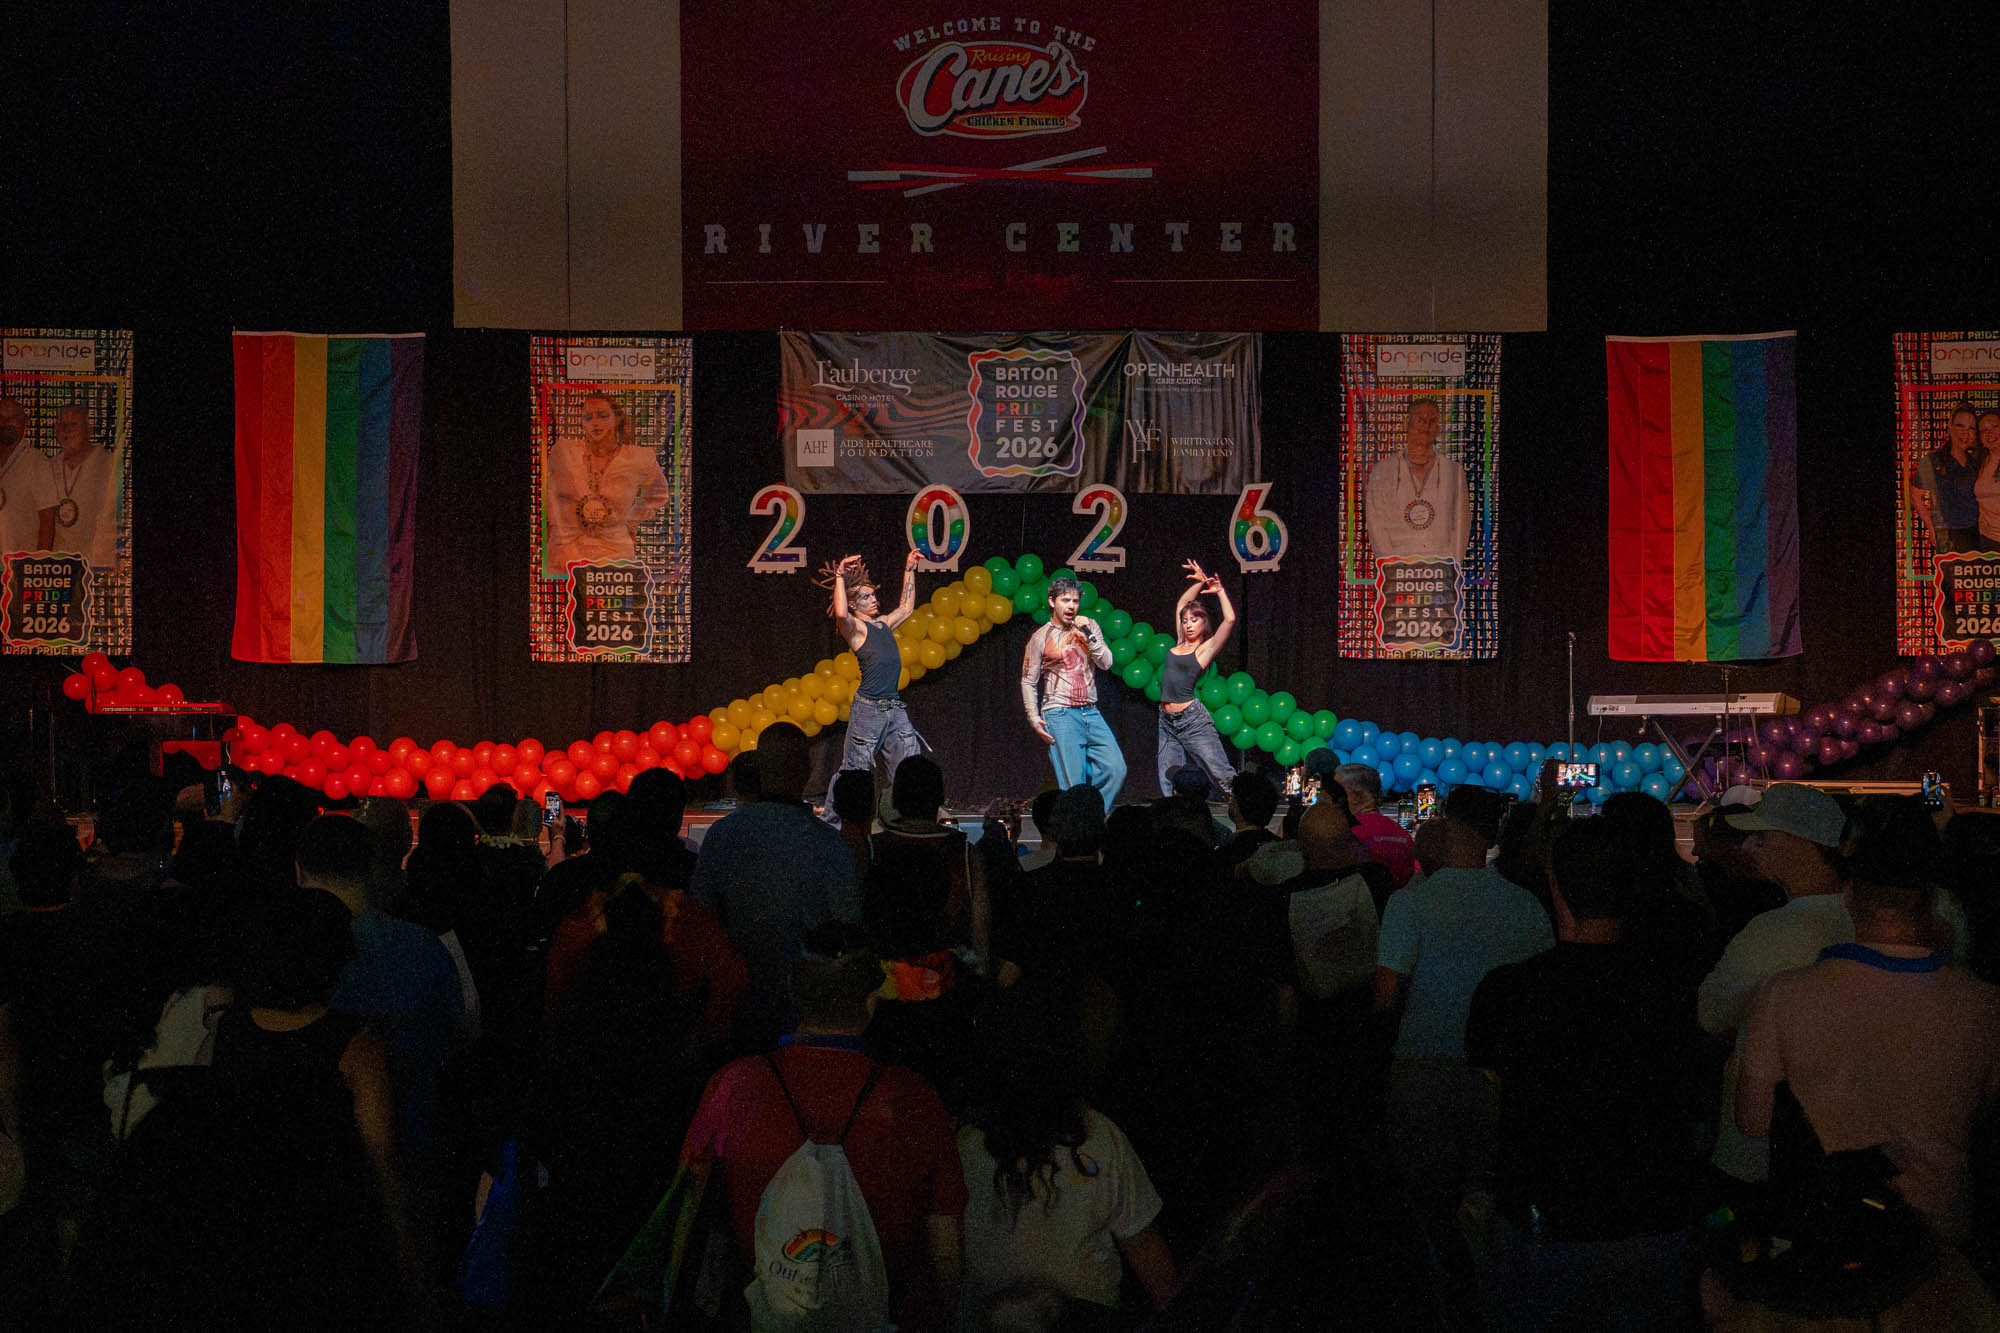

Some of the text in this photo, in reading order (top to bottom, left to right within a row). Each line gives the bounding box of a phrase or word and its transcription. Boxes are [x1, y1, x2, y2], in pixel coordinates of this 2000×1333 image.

[893, 17, 1096, 52] WELCOME TO THE
[970, 49, 1032, 66] Raising
[908, 43, 1083, 129] Cane's
[704, 222, 1297, 254] RIVER CENTER
[5, 328, 38, 337] WHAT
[568, 337, 599, 347] WHAT
[602, 338, 632, 347] PRIDE
[570, 351, 653, 369] brpride
[1380, 347, 1463, 368] brpride
[1934, 347, 2000, 363] brpri
[995, 367, 1058, 381] BATON
[1124, 362, 1236, 378] OPENHEALTH
[995, 385, 1058, 398] ROUGE
[996, 419, 1059, 433] FEST
[802, 440, 829, 455] AHF
[840, 440, 934, 448] AIDS HEALTHCARE
[996, 436, 1060, 458] 2026
[840, 448, 934, 457] FOUNDATION
[24, 564, 72, 575] BATON
[1396, 568, 1444, 579] BATON
[1954, 565, 2000, 576] BATON
[24, 577, 72, 588] ROUGE
[586, 572, 633, 582] BATON
[1396, 582, 1444, 592] ROUGE
[1954, 578, 2000, 589] ROUGE
[586, 585, 633, 595] ROUGE
[23, 604, 71, 614] FEST
[1395, 608, 1443, 618] FEST
[1955, 604, 2000, 615] FEST
[586, 611, 634, 621] FEST
[23, 617, 71, 633] 2026
[1395, 621, 1444, 637] 2026
[1956, 617, 2000, 634] 2026
[586, 624, 634, 641] 2026
[2, 646, 34, 656] WHAT
[37, 646, 69, 655] PRIDE
[1377, 650, 1407, 659] WHAT
[1410, 650, 1441, 659] PRIDE
[568, 653, 598, 662] WHAT
[602, 653, 631, 662] PRIDE
